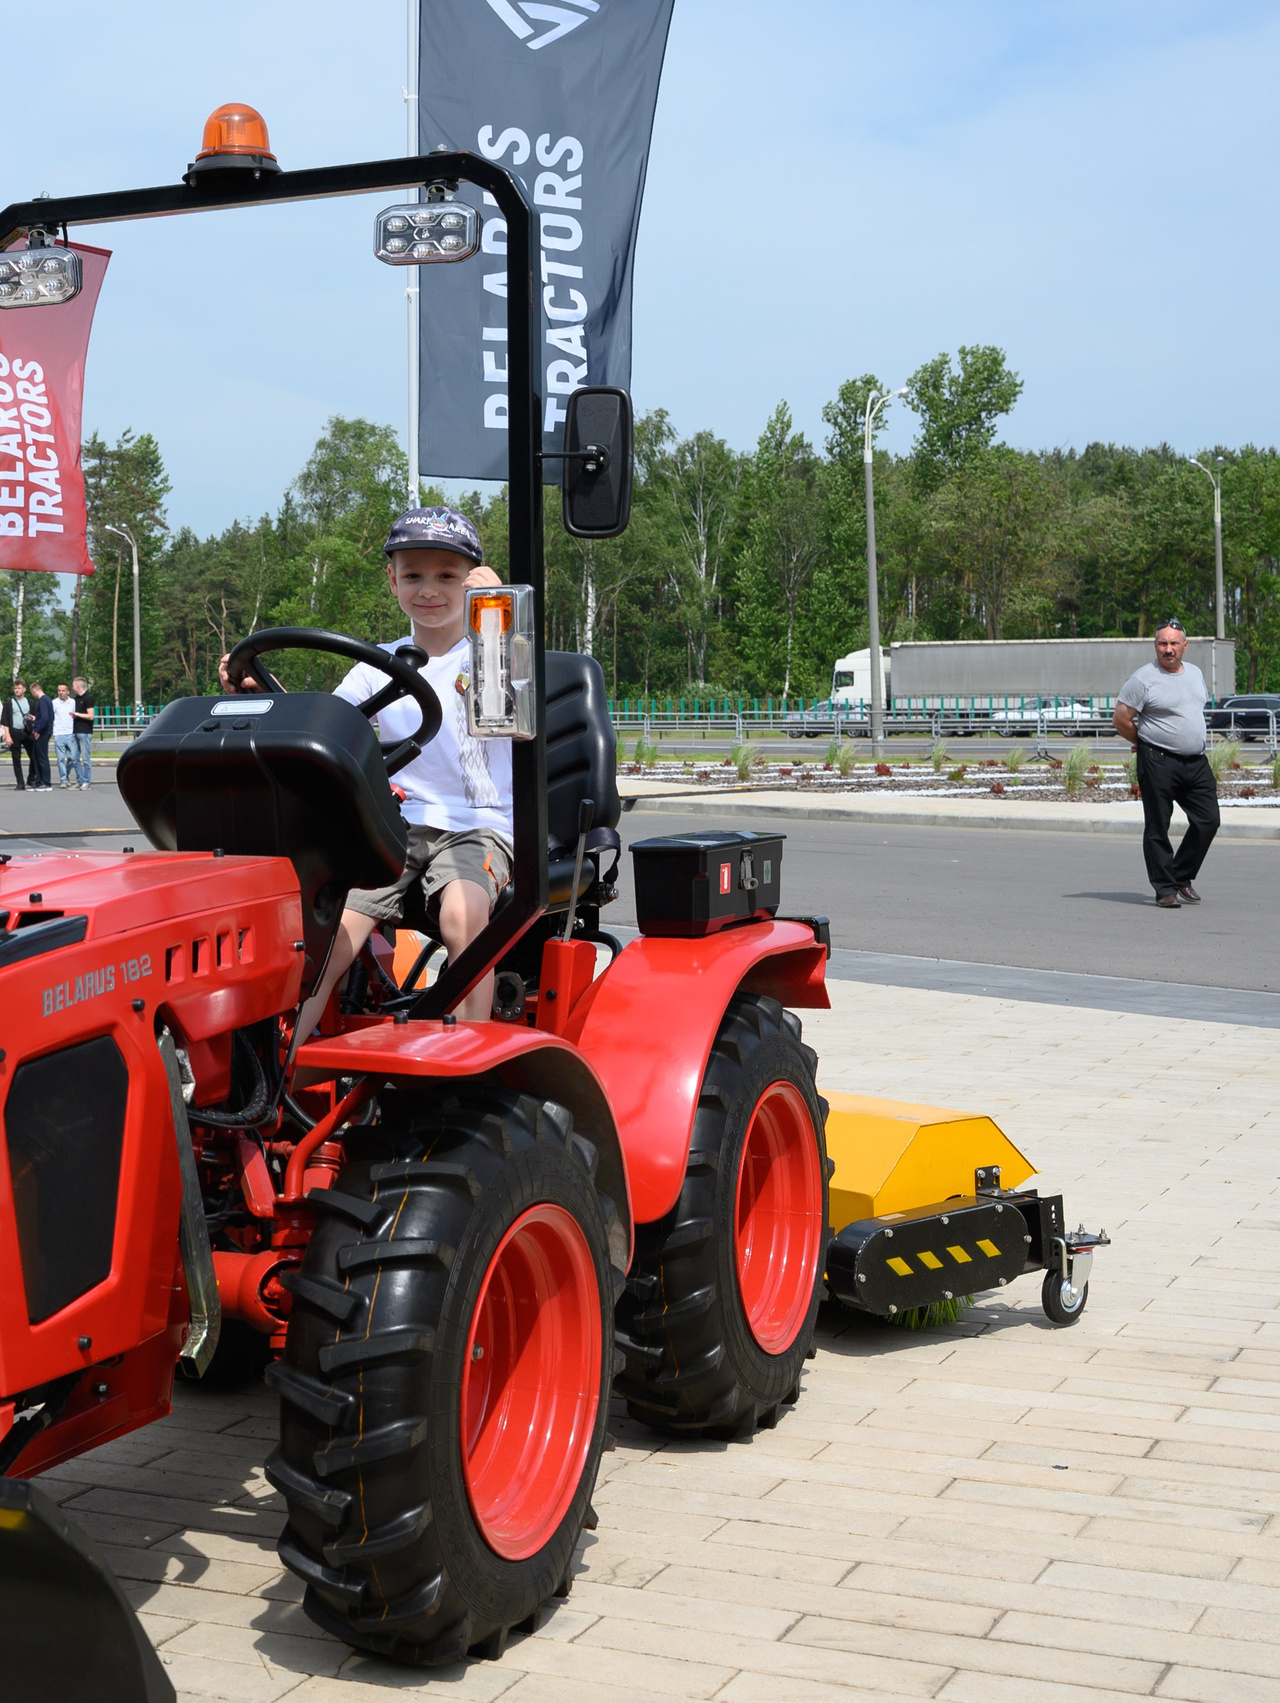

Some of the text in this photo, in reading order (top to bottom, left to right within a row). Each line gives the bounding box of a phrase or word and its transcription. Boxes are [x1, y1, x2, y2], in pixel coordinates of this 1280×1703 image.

[534, 133, 588, 432] TRACTORS
[12, 358, 64, 538] TRACTORS
[448, 522, 470, 539] AREA
[41, 953, 153, 1018] BELARUS 182
